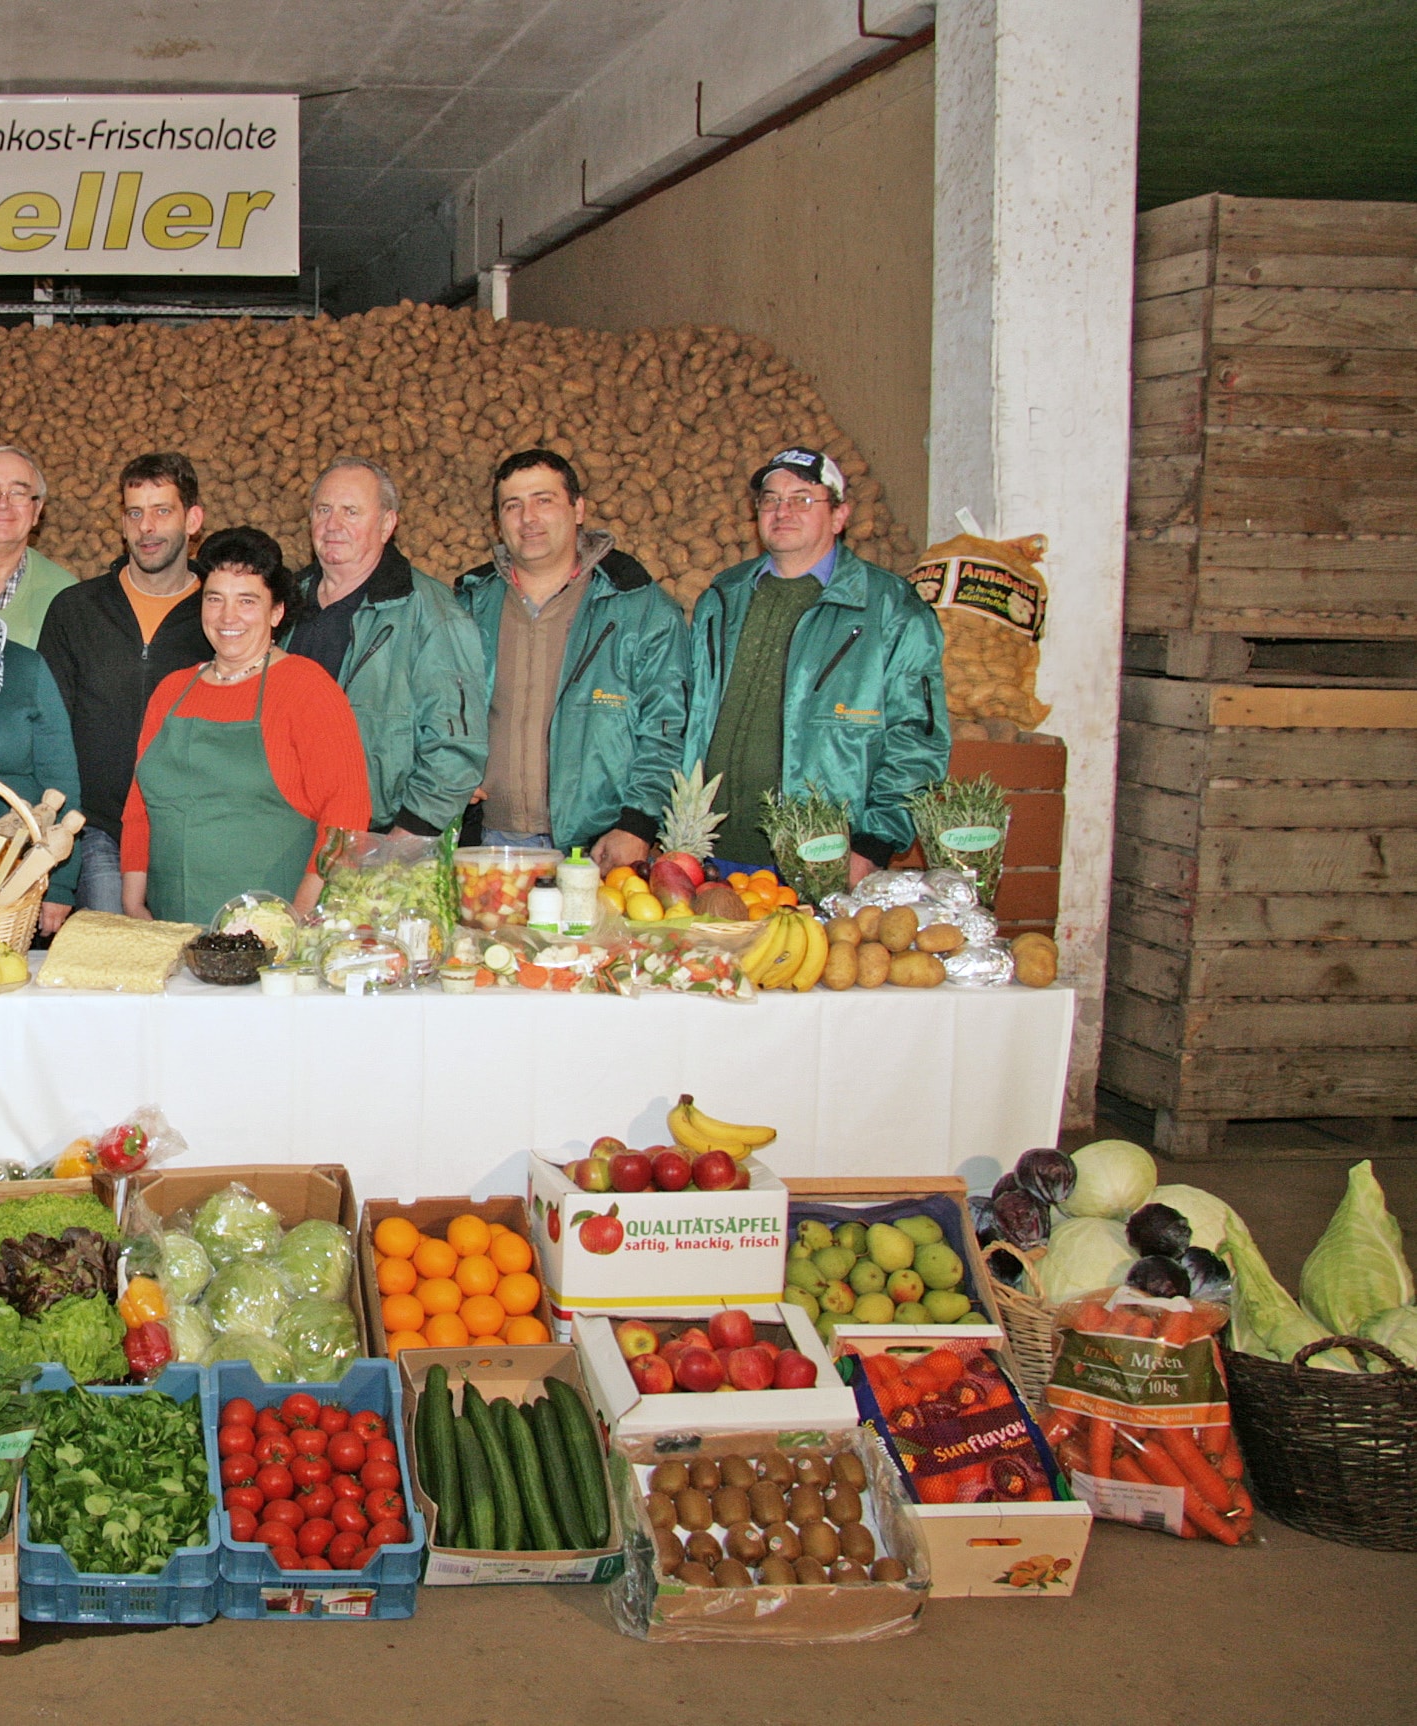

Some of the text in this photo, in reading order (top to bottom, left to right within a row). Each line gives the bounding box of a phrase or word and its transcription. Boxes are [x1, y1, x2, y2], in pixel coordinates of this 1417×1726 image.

[961, 563, 1037, 601] Annabelle
[625, 1216, 781, 1237] QUALITÄTSÄPFEL
[624, 1235, 780, 1254] saftig, knackig, frisch
